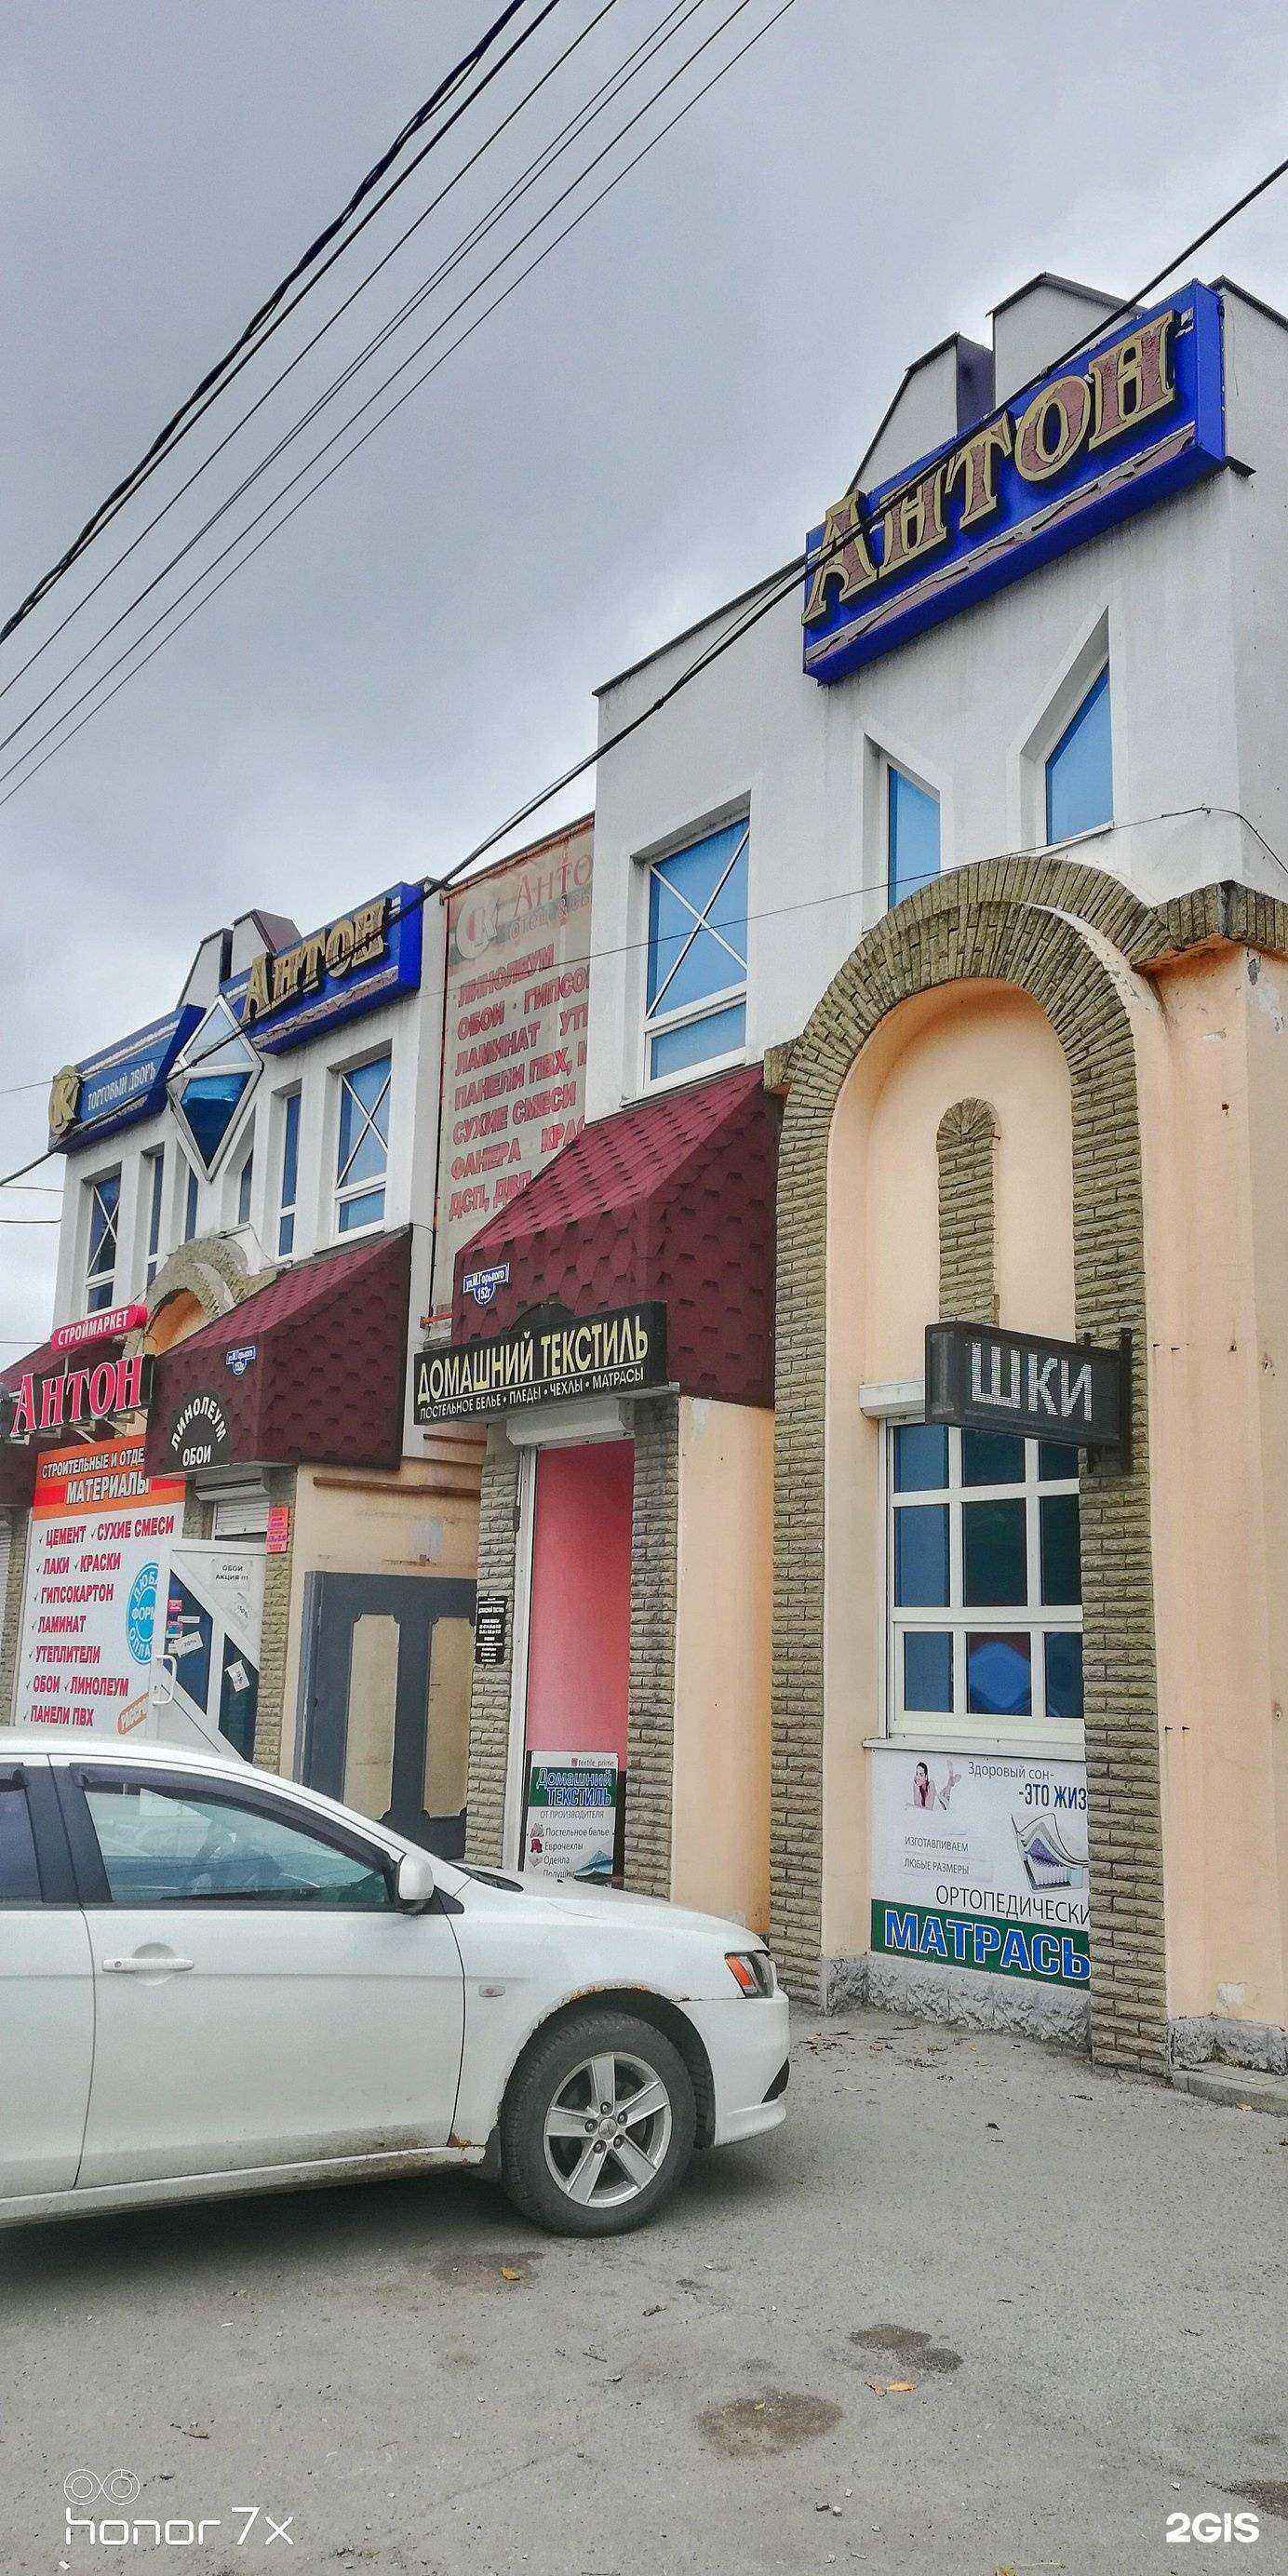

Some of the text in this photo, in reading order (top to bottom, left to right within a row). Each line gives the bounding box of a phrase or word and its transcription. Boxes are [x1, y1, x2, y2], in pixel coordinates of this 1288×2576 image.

[458, 943, 555, 1007] ЛИНОЛЕУМ
[457, 1001, 505, 1040] ОБОИ
[455, 1021, 541, 1077] ЛАМИНАТ
[455, 1063, 525, 1111] ПАНЕЛИ
[530, 1047, 572, 1083] ПВХ,
[453, 1081, 577, 1145] СУХИЕ СМЕСИ
[451, 1138, 521, 1180] ФАНЕРА
[58, 1310, 129, 1346] СТРОЙМАРКЕТ
[418, 1315, 649, 1405] ДОМАШНИЙ ТЕКСТИЛЬ
[420, 1367, 644, 1420] ПОСТЕЛЬНОЕ БЕЛЬЕ ПЛЕДЫ ЧЕХЛЫ МАТРАСЫ
[971, 1342, 1093, 1422] ШКИ
[171, 1397, 227, 1451] ЛИНОЛЕУМ
[42, 1453, 109, 1478] СТРОИТЕЛЬНЫЕ
[111, 1453, 117, 1468] И
[182, 1445, 211, 1467] ОБОИ
[46, 1516, 175, 1548] ЦЕМЕНТ СУХИЕ СМЕСИ
[43, 1552, 122, 1575] ЛАКИ КРАСКИ
[40, 1584, 114, 1603] ГИПСОКАРТОН
[38, 1616, 87, 1633] ЛАМИНАТ
[35, 1645, 101, 1663] УТЕПЛИТЕЛИ
[33, 1675, 129, 1697] ОБОИ ЛИНОЛЕУМ
[30, 1705, 95, 1726] ПАНЕЛИ ПВХ
[536, 1768, 612, 1791] Домашний
[968, 1761, 1026, 1780] Здоровый
[546, 1787, 611, 1806] ТЕКСТИЛЬ
[550, 1810, 604, 1819] ПРОИЗВОДИТЕЛЯ
[545, 1827, 610, 1837] Постельное белье
[544, 1842, 583, 1851] Еврочехлы
[905, 1836, 969, 1852] ИЗГОТАВЛИВАЕМ
[904, 1858, 970, 1875] ЛЮБЫЕ РАЗМЕРЫ
